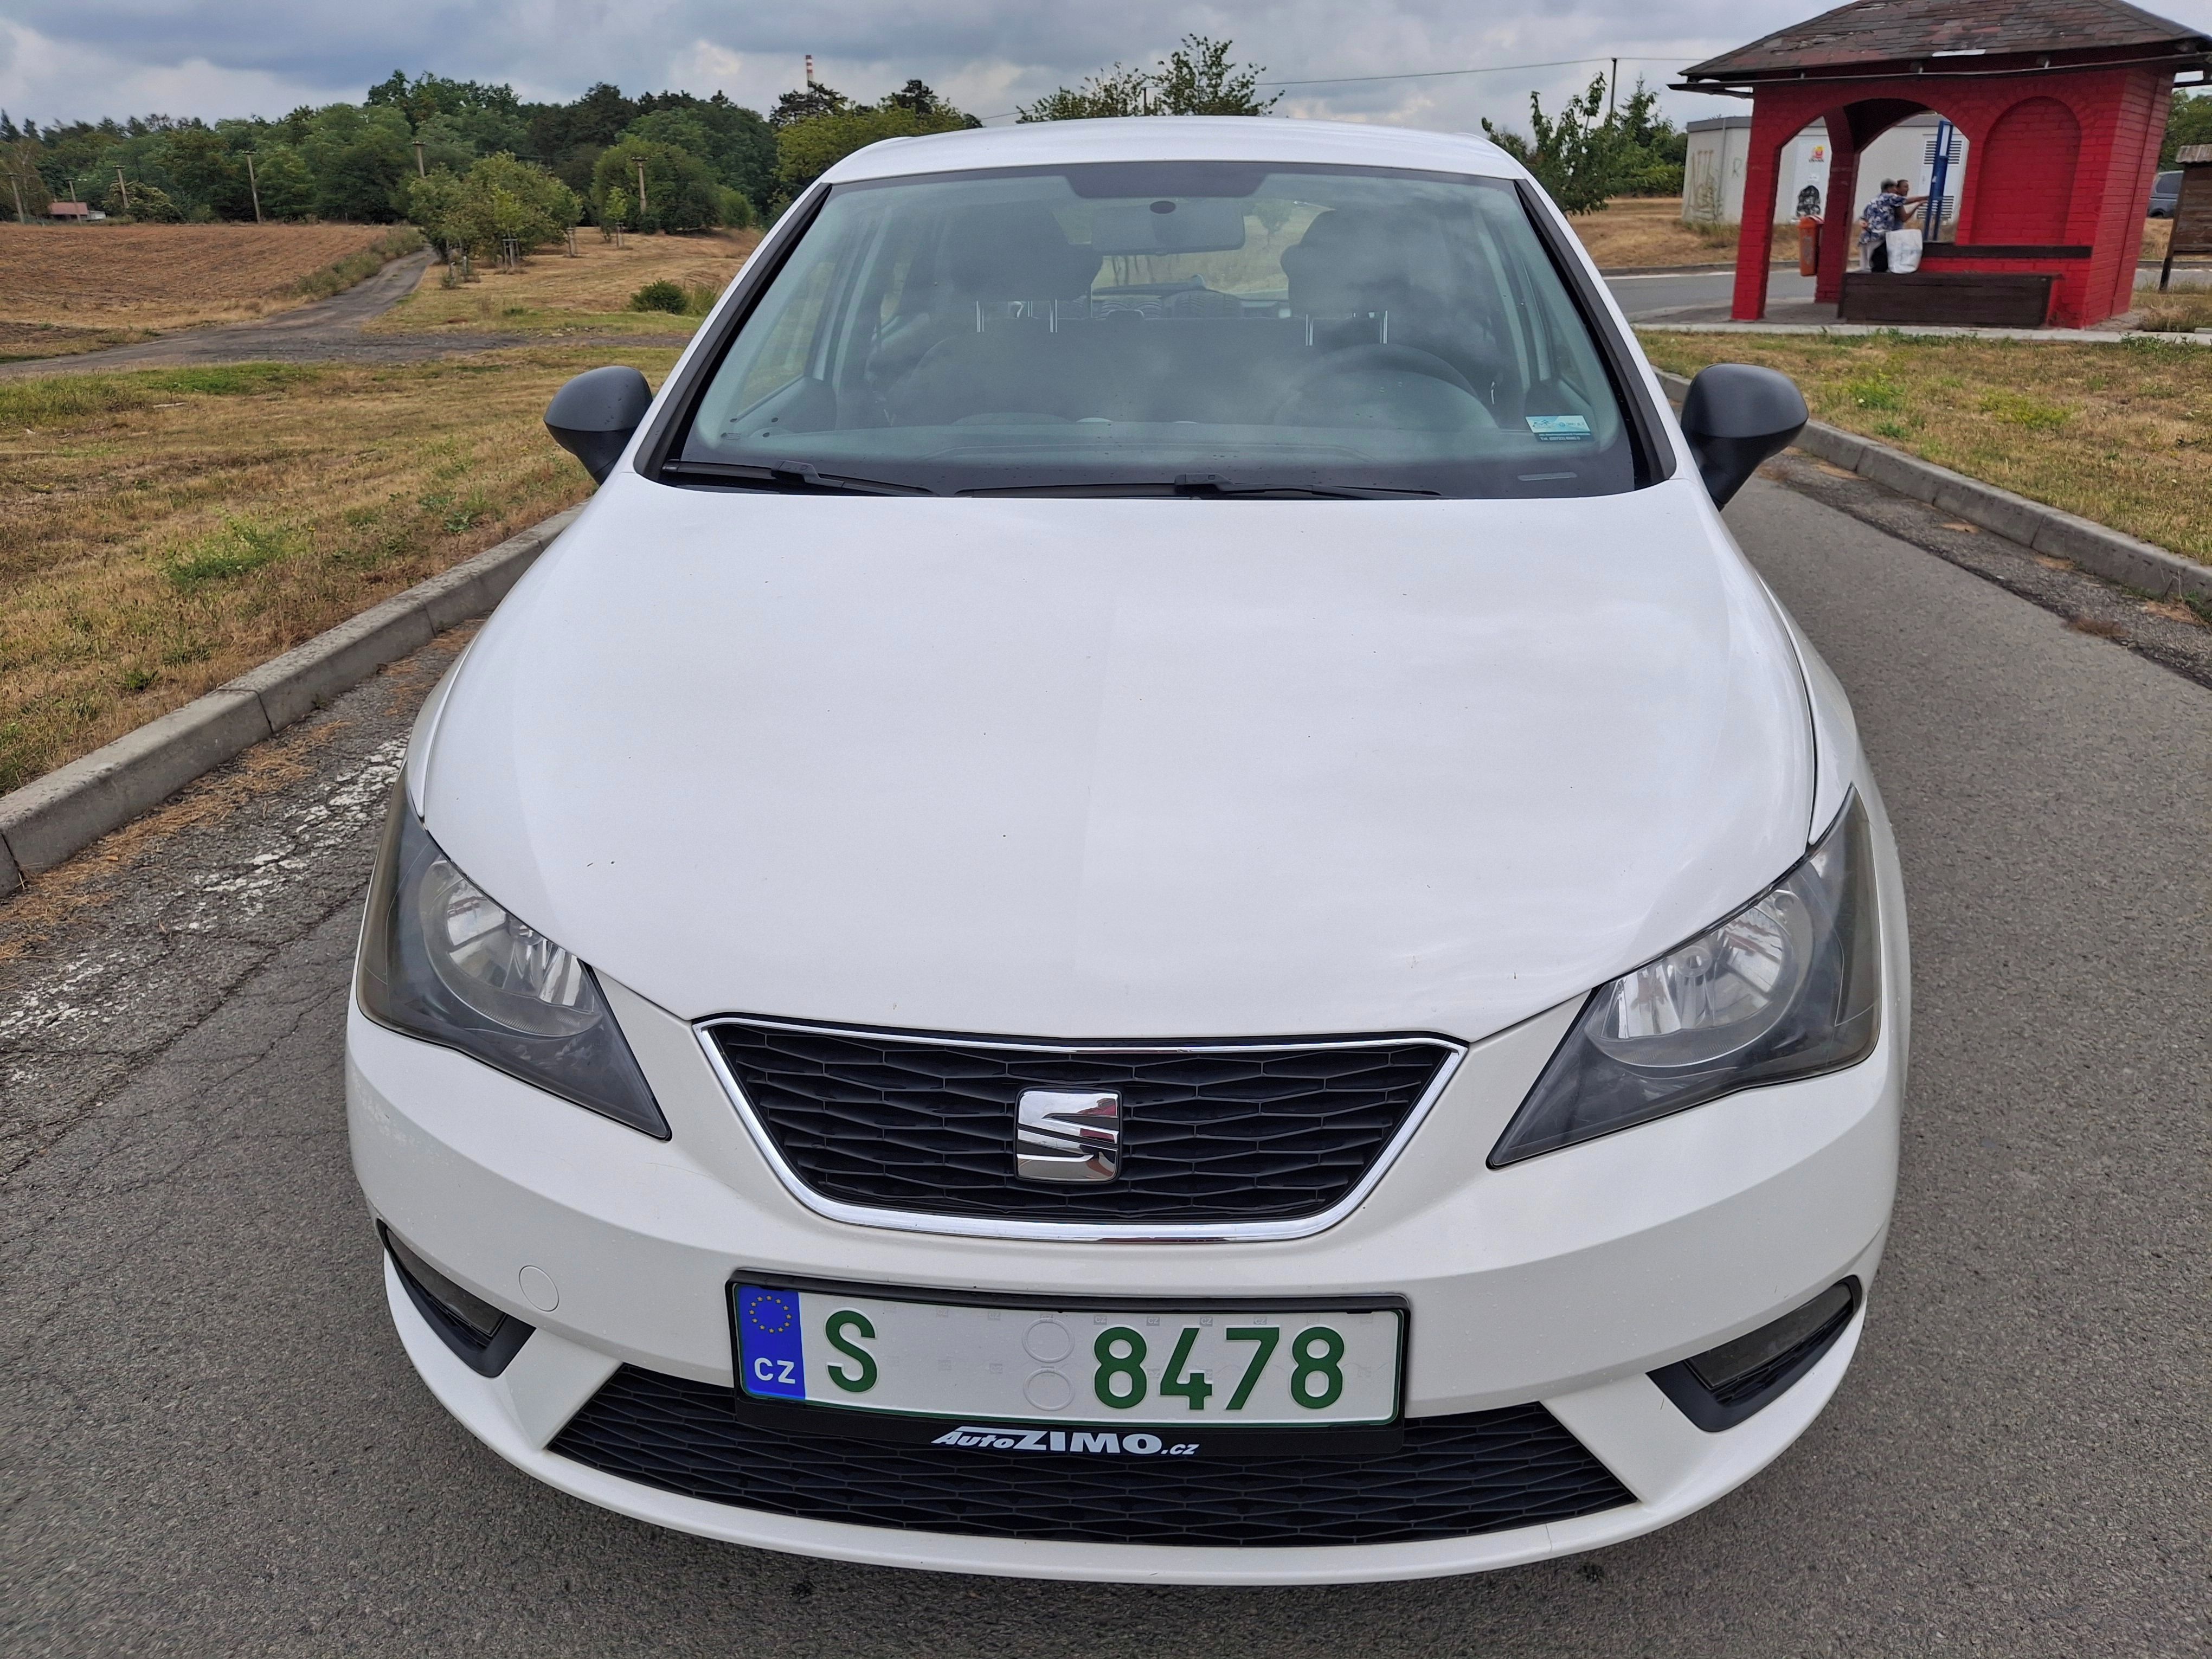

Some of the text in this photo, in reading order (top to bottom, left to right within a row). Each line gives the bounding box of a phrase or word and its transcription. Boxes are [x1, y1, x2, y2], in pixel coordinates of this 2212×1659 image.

[754, 1357, 796, 1384] CZ
[825, 1309, 1345, 1410] S 8478
